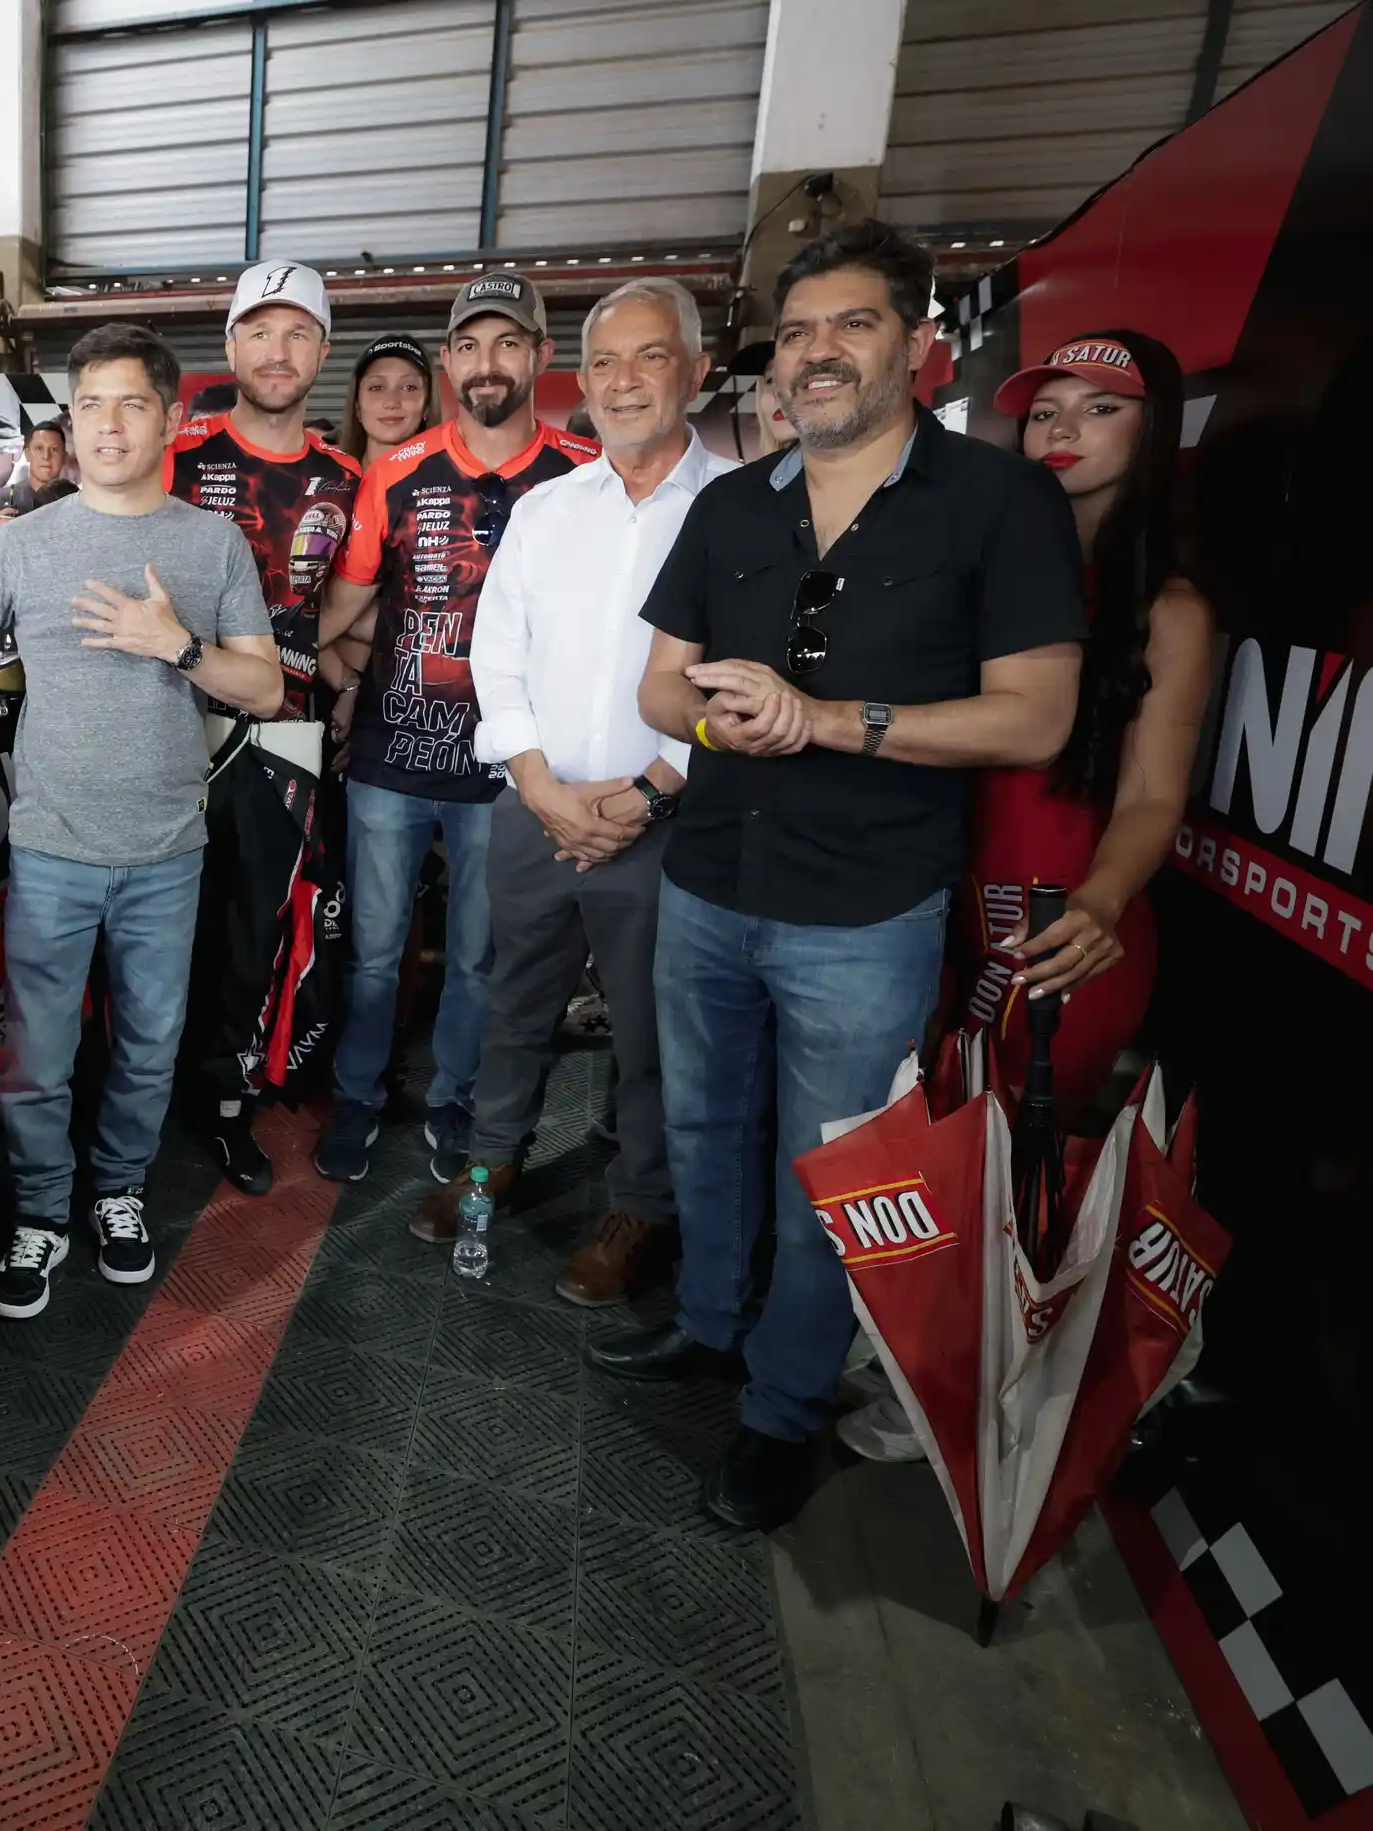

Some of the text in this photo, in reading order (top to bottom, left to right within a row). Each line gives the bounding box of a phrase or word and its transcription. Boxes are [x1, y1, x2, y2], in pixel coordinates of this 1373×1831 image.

[1063, 345, 1131, 368] SATUR
[207, 462, 237, 470] SCIENZA
[206, 473, 237, 483] Kappa
[200, 486, 237, 495] PARDO
[421, 485, 452, 495] SCIENZA
[207, 496, 236, 506] JELUZ
[420, 497, 451, 507] Kappa
[416, 510, 452, 521] PARDO
[422, 521, 450, 532] JELUZ
[396, 608, 463, 656] PEN
[276, 645, 317, 677] ANNING
[391, 647, 423, 696] TA
[383, 690, 471, 736] CAM
[969, 960, 1014, 1024] DON
[844, 1191, 939, 1249] DON
